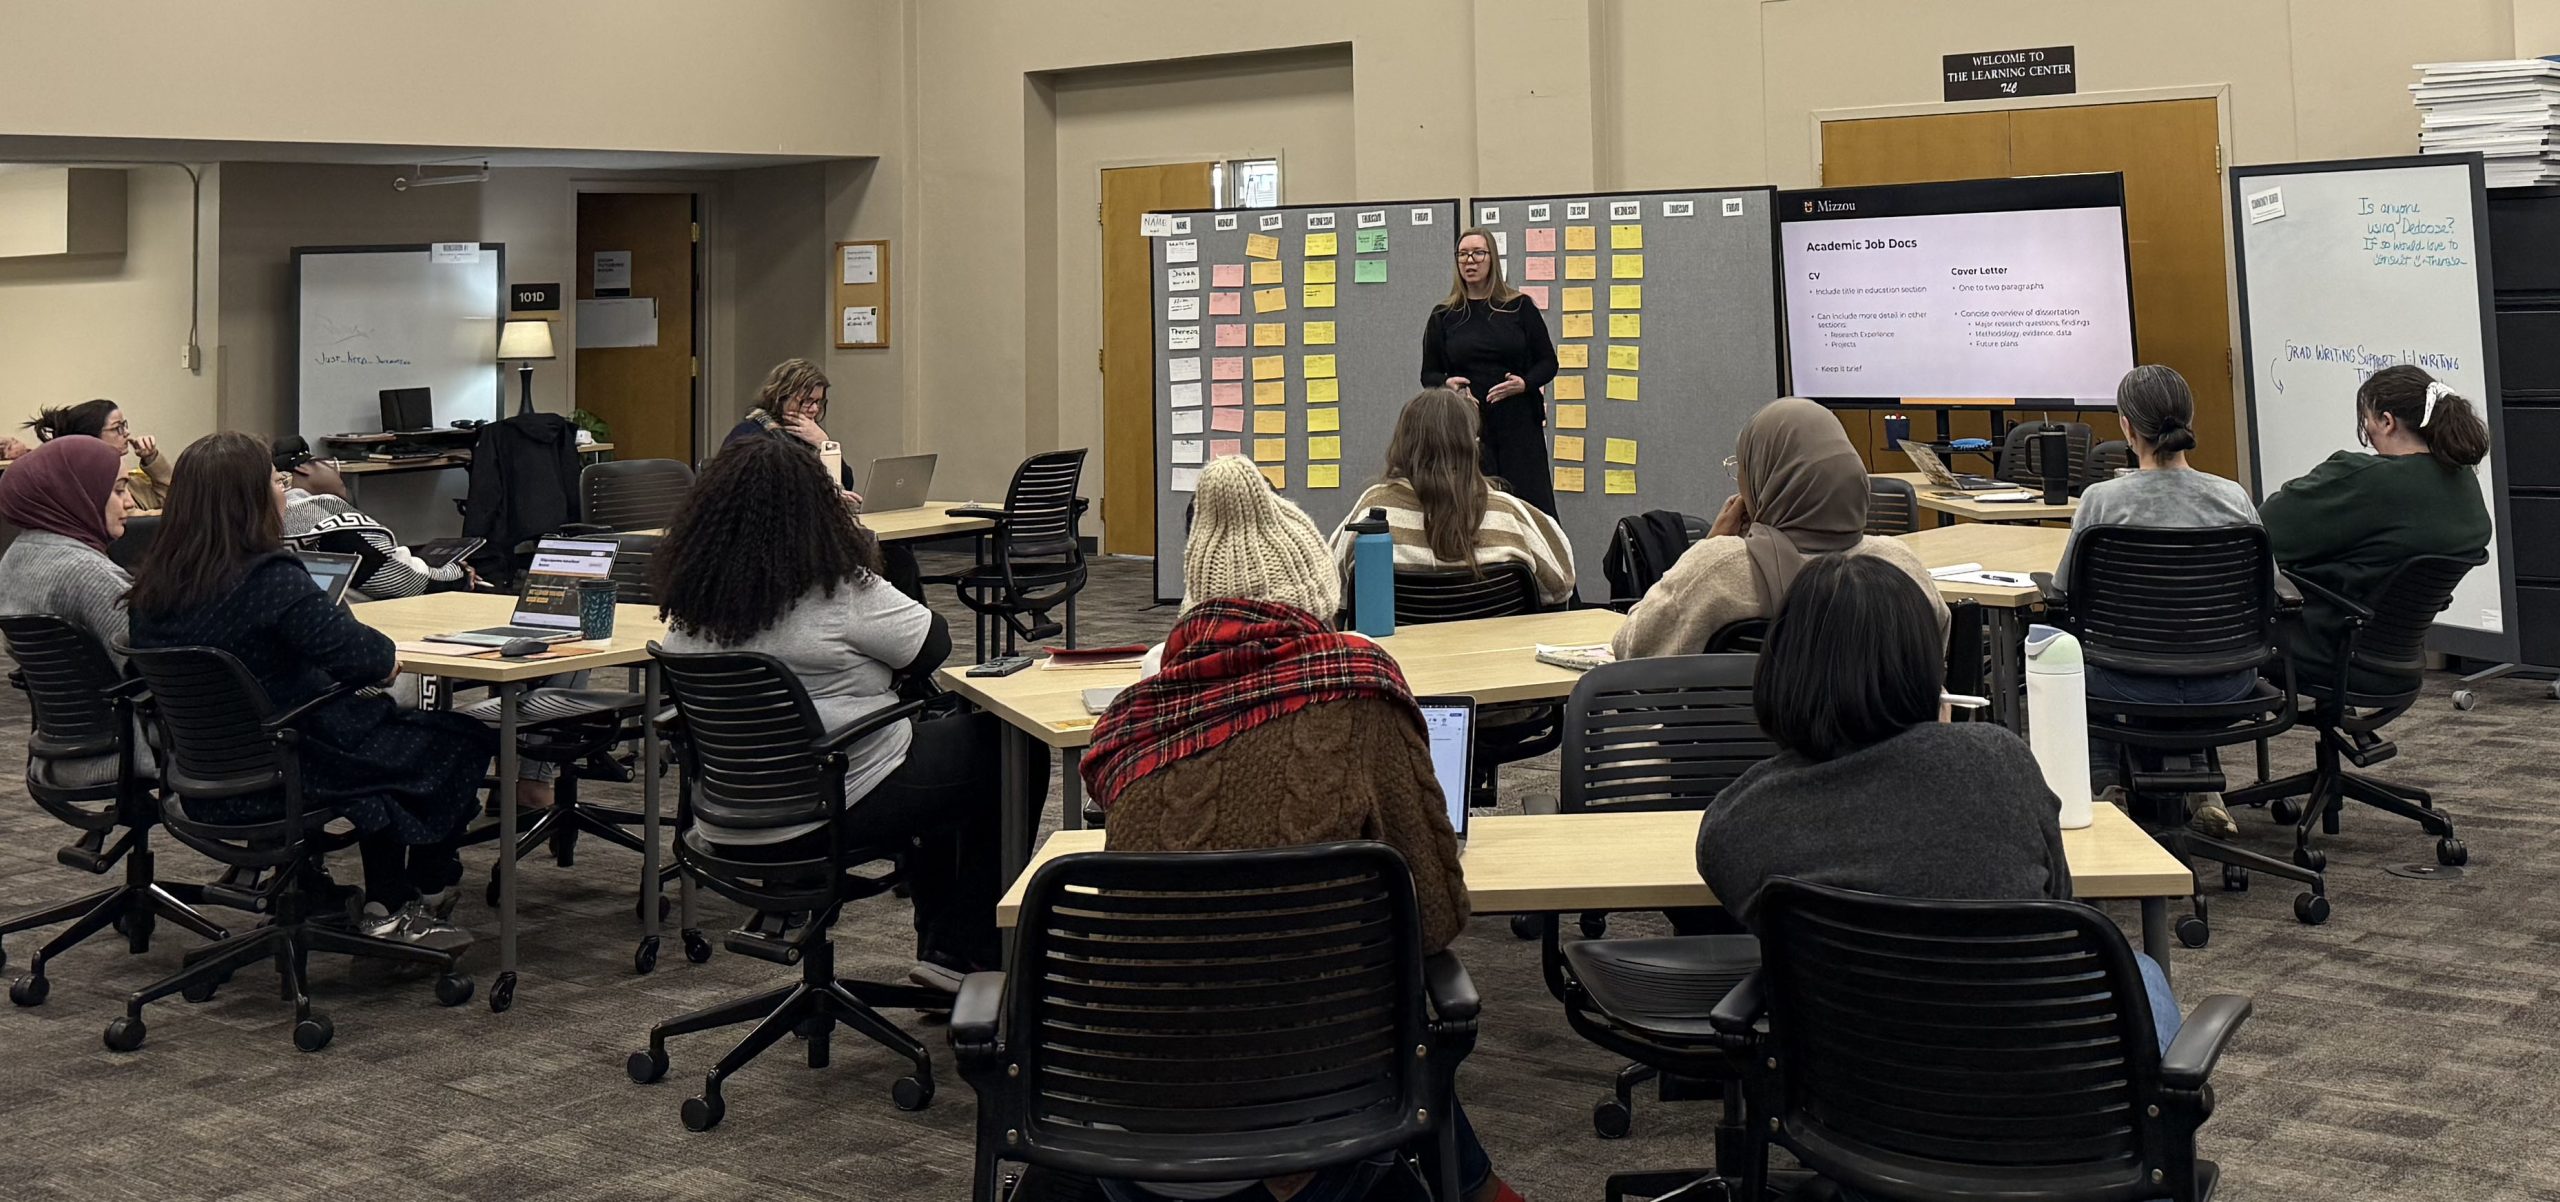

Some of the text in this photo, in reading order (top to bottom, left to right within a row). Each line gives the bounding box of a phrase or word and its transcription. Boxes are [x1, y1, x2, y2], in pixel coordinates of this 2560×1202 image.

[1972, 51, 2044, 66] WELCOME TO
[1947, 63, 2072, 82] THE LEARNING CENTER
[1817, 200, 1856, 212] Mizzou
[2358, 197, 2420, 224] Is anyone
[1144, 216, 1167, 227] NAME
[2367, 223, 2396, 240] using
[1806, 238, 1918, 252] Academic Job Docs
[2393, 240, 2424, 251] would
[2427, 239, 2446, 251] love
[1808, 272, 1821, 280] CV
[1951, 266, 2008, 275] Cover Letter
[1865, 286, 1900, 294] education
[1958, 284, 1974, 292] One
[2001, 282, 2044, 292] paragraphs
[518, 291, 545, 302] 101D
[1832, 312, 1858, 320] include
[1879, 311, 1898, 319] detail
[1960, 310, 1989, 318] Concise
[1991, 309, 2024, 317] overview
[2035, 308, 2080, 316] dissertation
[1975, 320, 1993, 329] Major
[2061, 318, 2090, 327] findings
[1831, 341, 1856, 349] Projects
[2000, 340, 2019, 349] plans
[2285, 339, 2311, 362] GRAD
[1821, 365, 1839, 373] Keep
